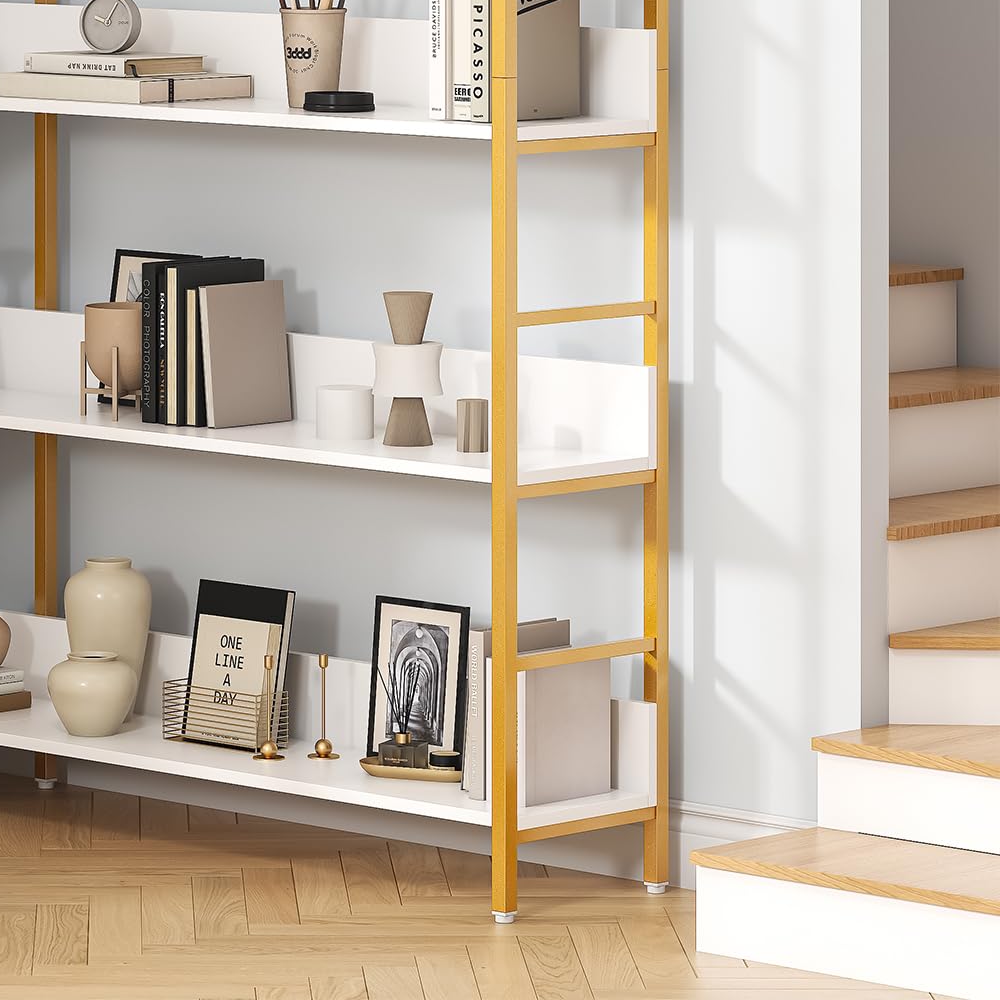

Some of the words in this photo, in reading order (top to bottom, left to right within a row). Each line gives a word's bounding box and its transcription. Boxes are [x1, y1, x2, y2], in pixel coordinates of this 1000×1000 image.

[472, 4, 484, 99] PICASSO
[67, 62, 81, 70] NAP
[82, 63, 103, 71] DRINK
[103, 64, 116, 72] EAT
[143, 279, 151, 318] COLOR
[143, 325, 151, 408] PHOTOGRAPHY
[220, 634, 243, 651] ONE
[214, 652, 245, 670] LINE
[470, 645, 478, 681] WORLD
[222, 673, 231, 687] A
[213, 690, 238, 706] DAY
